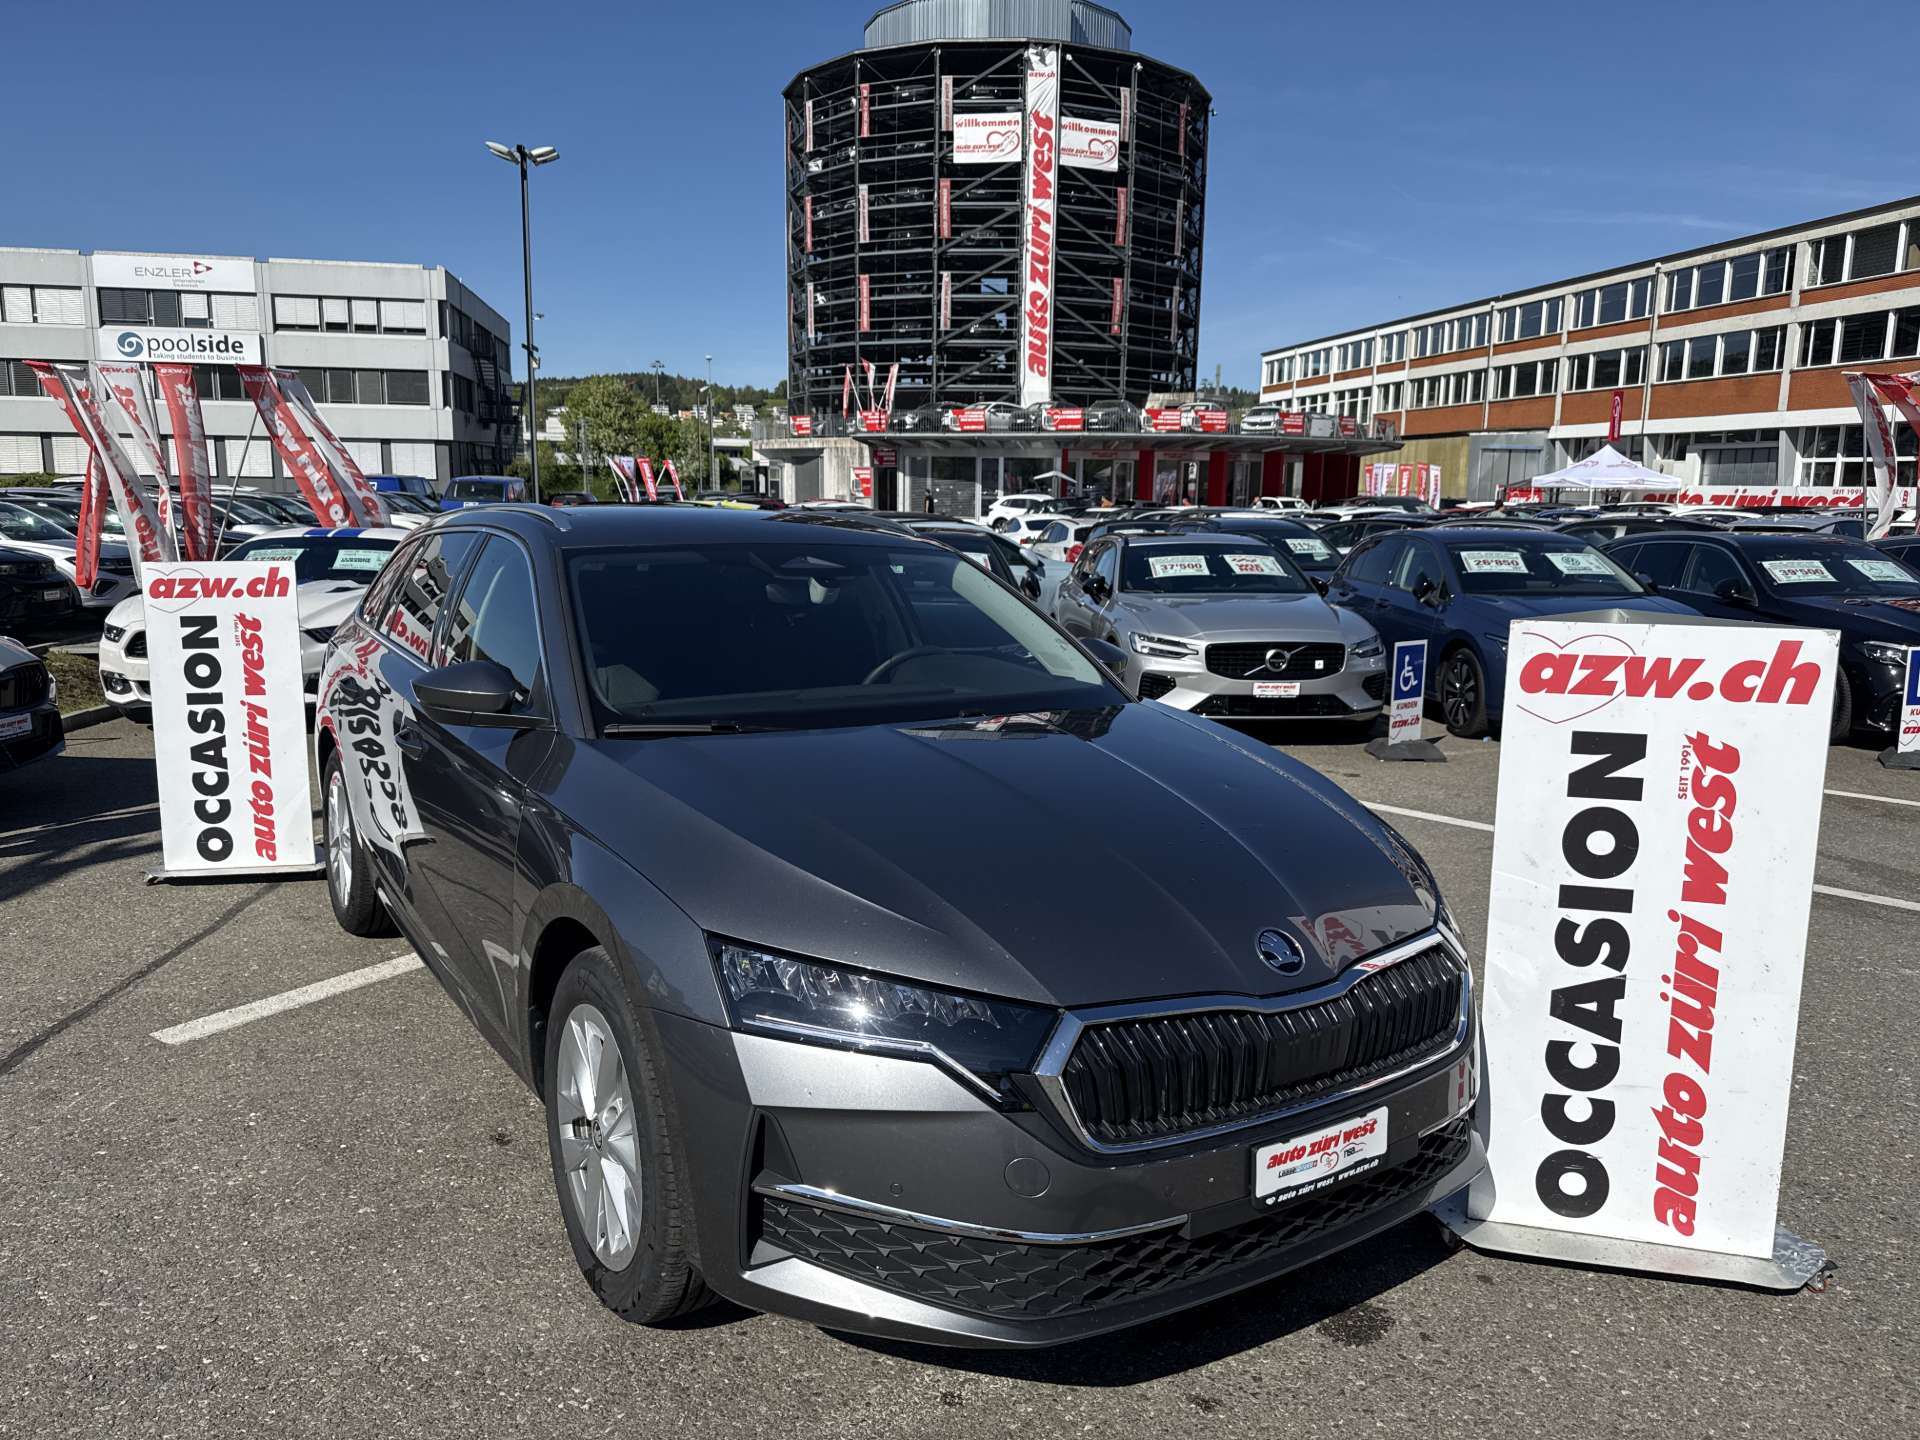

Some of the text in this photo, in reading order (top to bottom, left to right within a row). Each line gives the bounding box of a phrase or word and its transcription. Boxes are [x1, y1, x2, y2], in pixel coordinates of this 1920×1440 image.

[955, 118, 1020, 128] willkommen
[1060, 121, 1118, 137] willkommen
[1025, 109, 1054, 378] auto züri west
[134, 266, 192, 278] ENZLER
[146, 333, 244, 358] poolside
[154, 352, 175, 361] taking
[176, 353, 207, 361] students
[1832, 488, 1845, 496] SEIT
[148, 567, 291, 600] azw.ch
[1779, 567, 1825, 577] 39'500
[1518, 640, 1822, 706] azw.ch
[1396, 700, 1418, 711] KUNDEN
[1391, 714, 1420, 729] azw.ch
[179, 615, 234, 863] OCCASION
[234, 611, 278, 862] auto züri west
[1678, 743, 1693, 801] SEIT 1991
[1535, 729, 1649, 1219] OCCASION
[1651, 730, 1741, 1238] auto züri west
[1266, 1145, 1307, 1170] auto
[1307, 1129, 1342, 1157] züri
[1342, 1118, 1378, 1144] west
[1277, 1190, 1297, 1202] auto
[1316, 1176, 1335, 1189] west
